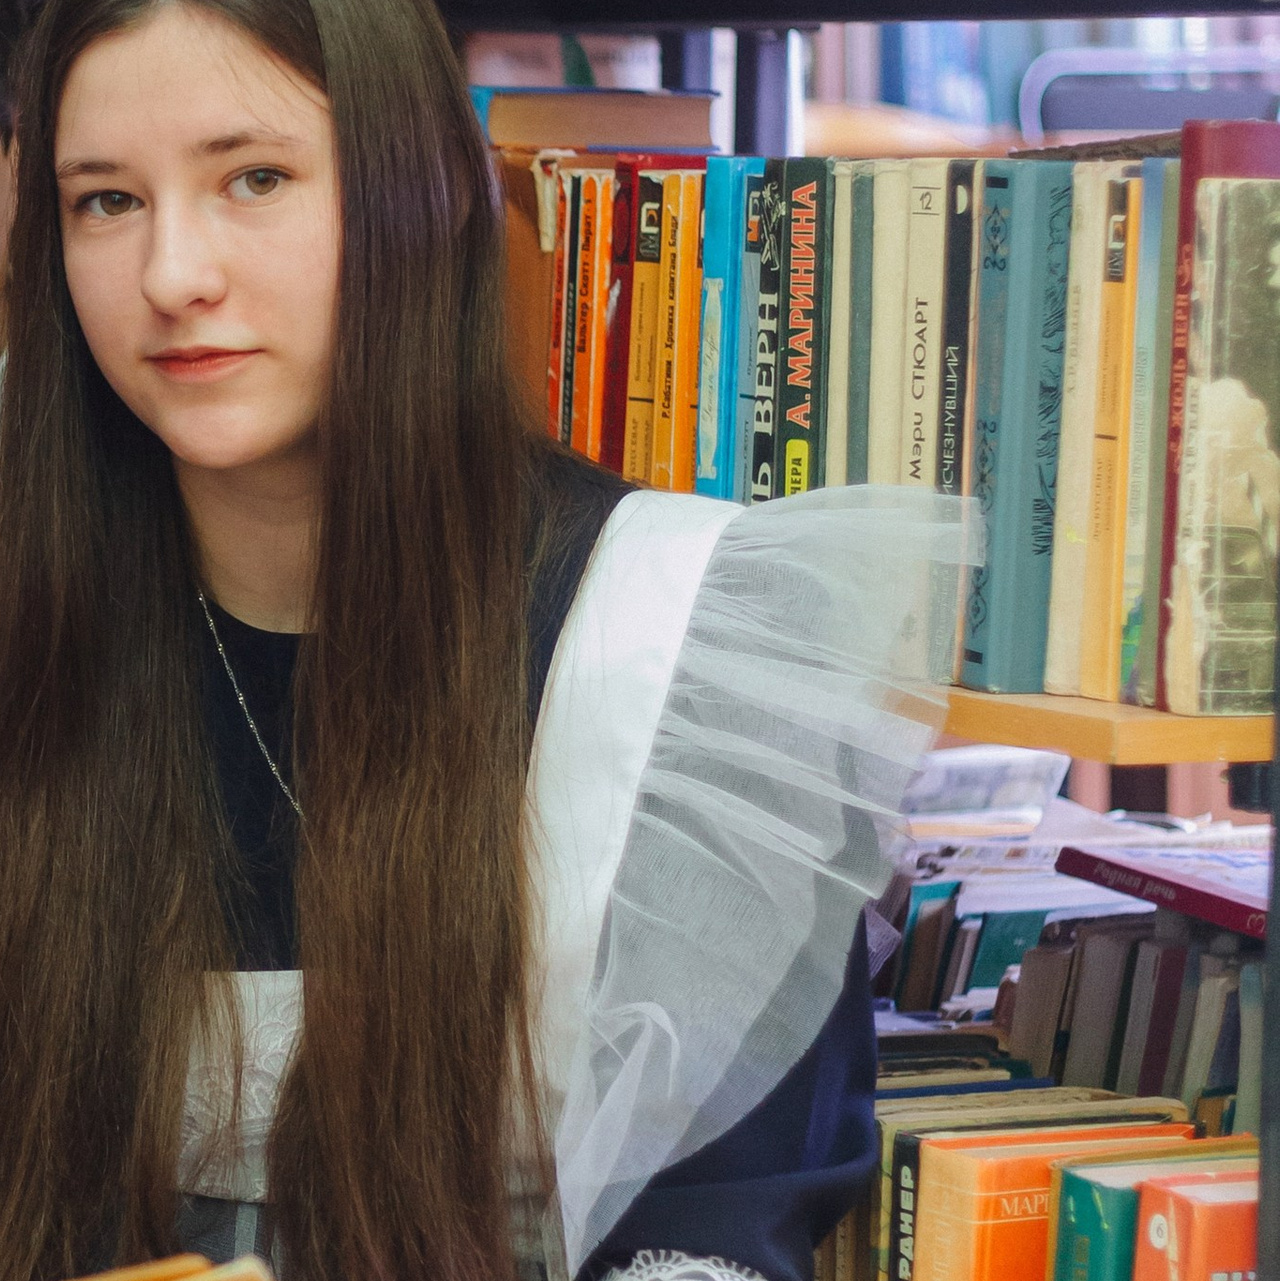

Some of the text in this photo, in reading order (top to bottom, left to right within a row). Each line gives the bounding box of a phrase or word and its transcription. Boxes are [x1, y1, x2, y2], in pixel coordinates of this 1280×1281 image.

[918, 191, 933, 210] 12
[581, 213, 593, 252] Пират
[579, 261, 589, 297] Скотт
[667, 252, 677, 301] капитана
[577, 301, 590, 354] Вальтер
[664, 305, 675, 350] Хроника
[785, 180, 818, 431] А. МАРИНИНА
[751, 291, 779, 438] ВЕРН
[907, 297, 929, 481] Мэри СТЮАРТ
